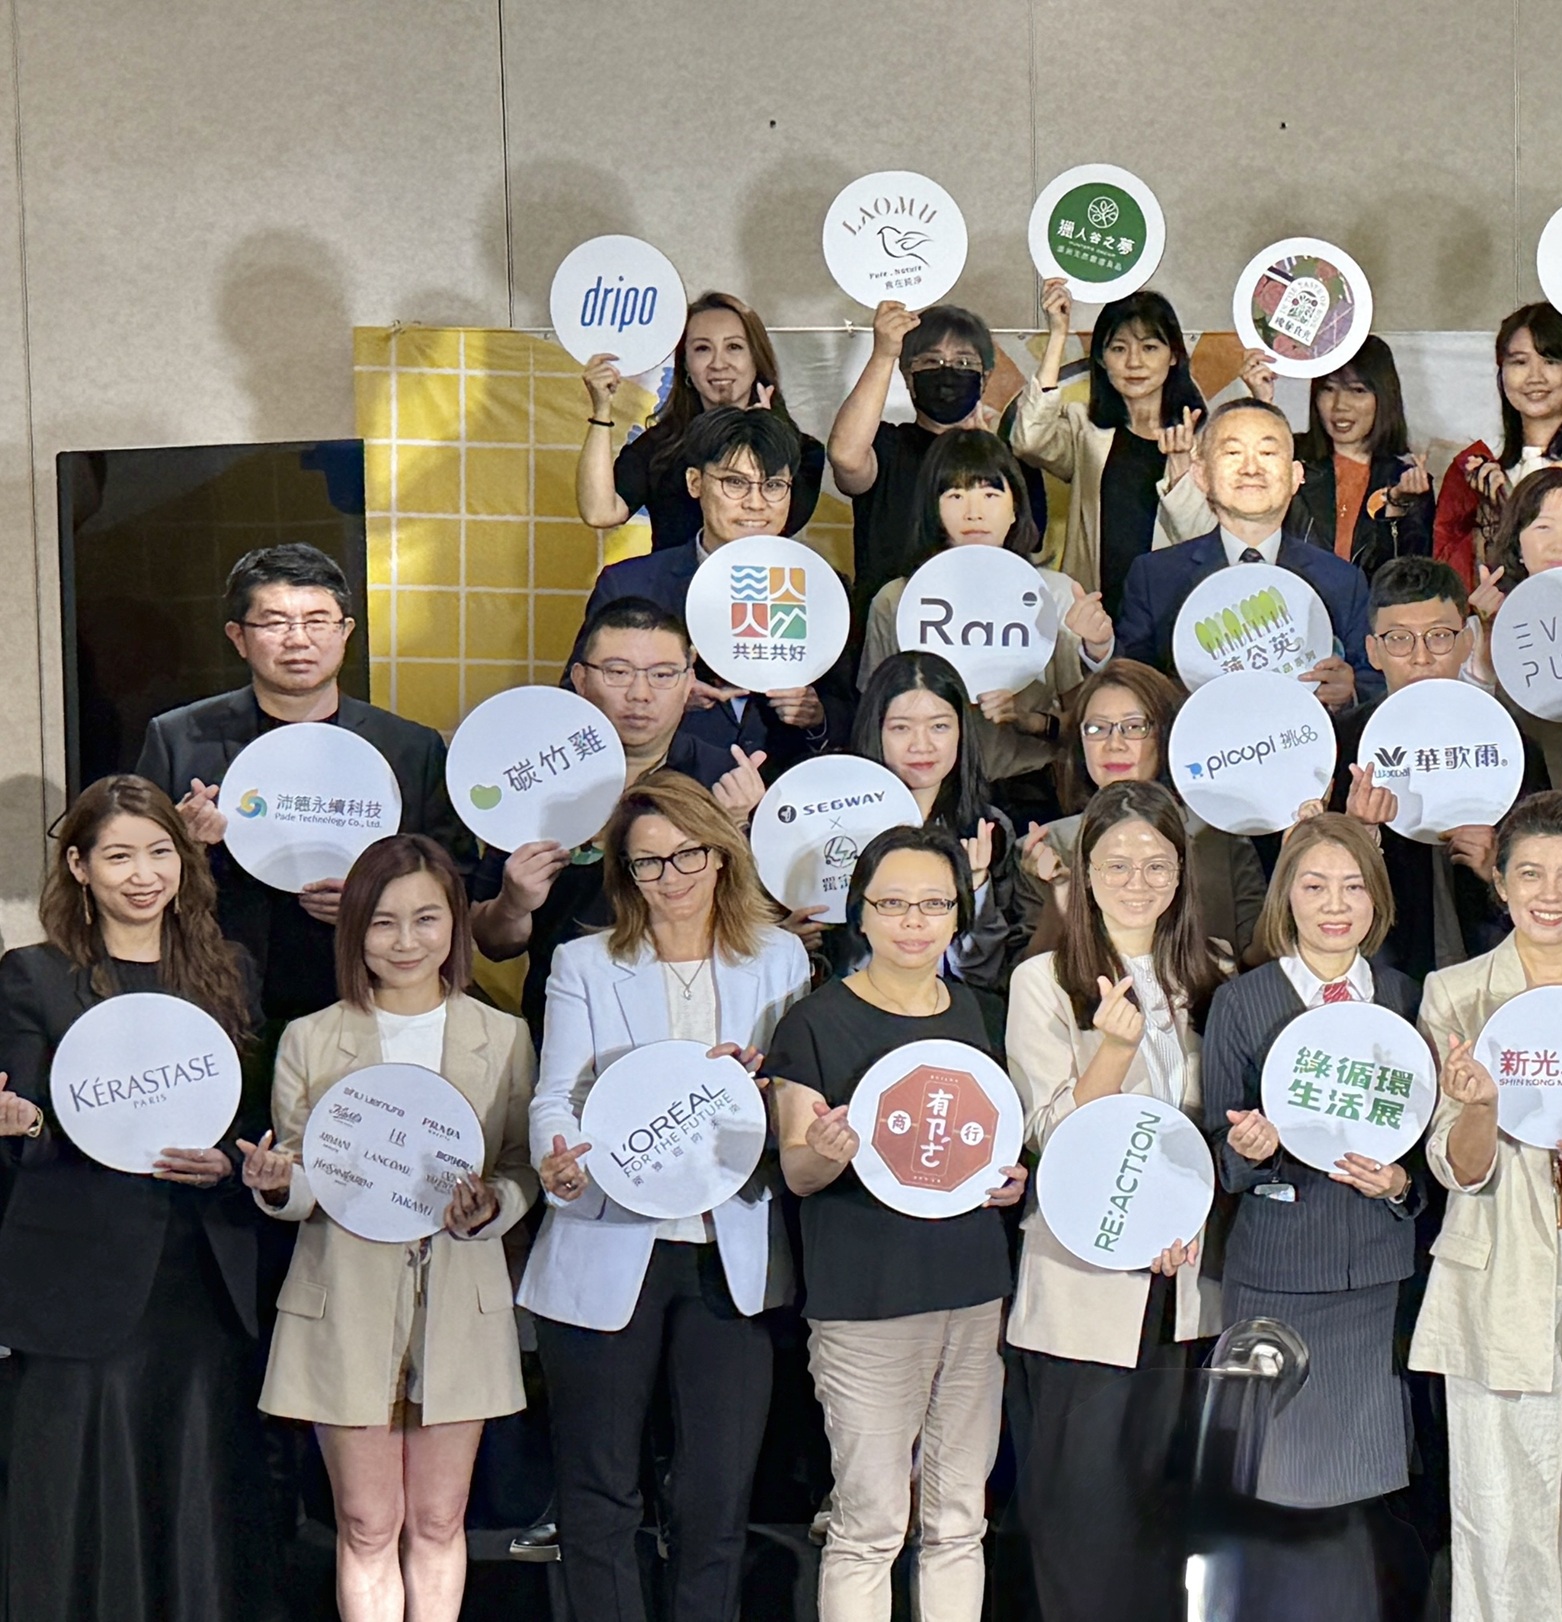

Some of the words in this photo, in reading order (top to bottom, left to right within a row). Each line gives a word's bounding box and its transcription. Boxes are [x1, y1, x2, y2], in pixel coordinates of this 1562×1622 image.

[580, 276, 658, 333] dripo
[920, 598, 1029, 648] Ran
[733, 643, 807, 662] 共生共好
[503, 725, 607, 793] 碳竹雞
[298, 813, 346, 828] Technology
[803, 790, 885, 816] SEGWAY
[69, 1053, 220, 1112] KÉRASTASE
[1293, 1046, 1414, 1099] 綠循環
[133, 1093, 167, 1109] PARIS
[610, 1084, 726, 1168] L'ORÉAL
[1287, 1079, 1405, 1130] 生活展
[623, 1153, 652, 1178] FOR
[653, 1131, 681, 1155] THE
[680, 1092, 733, 1135] FUTURE
[964, 1125, 980, 1142] 行
[391, 1191, 433, 1216] TAKAMI
[1094, 1110, 1162, 1253] RE:ACTION
